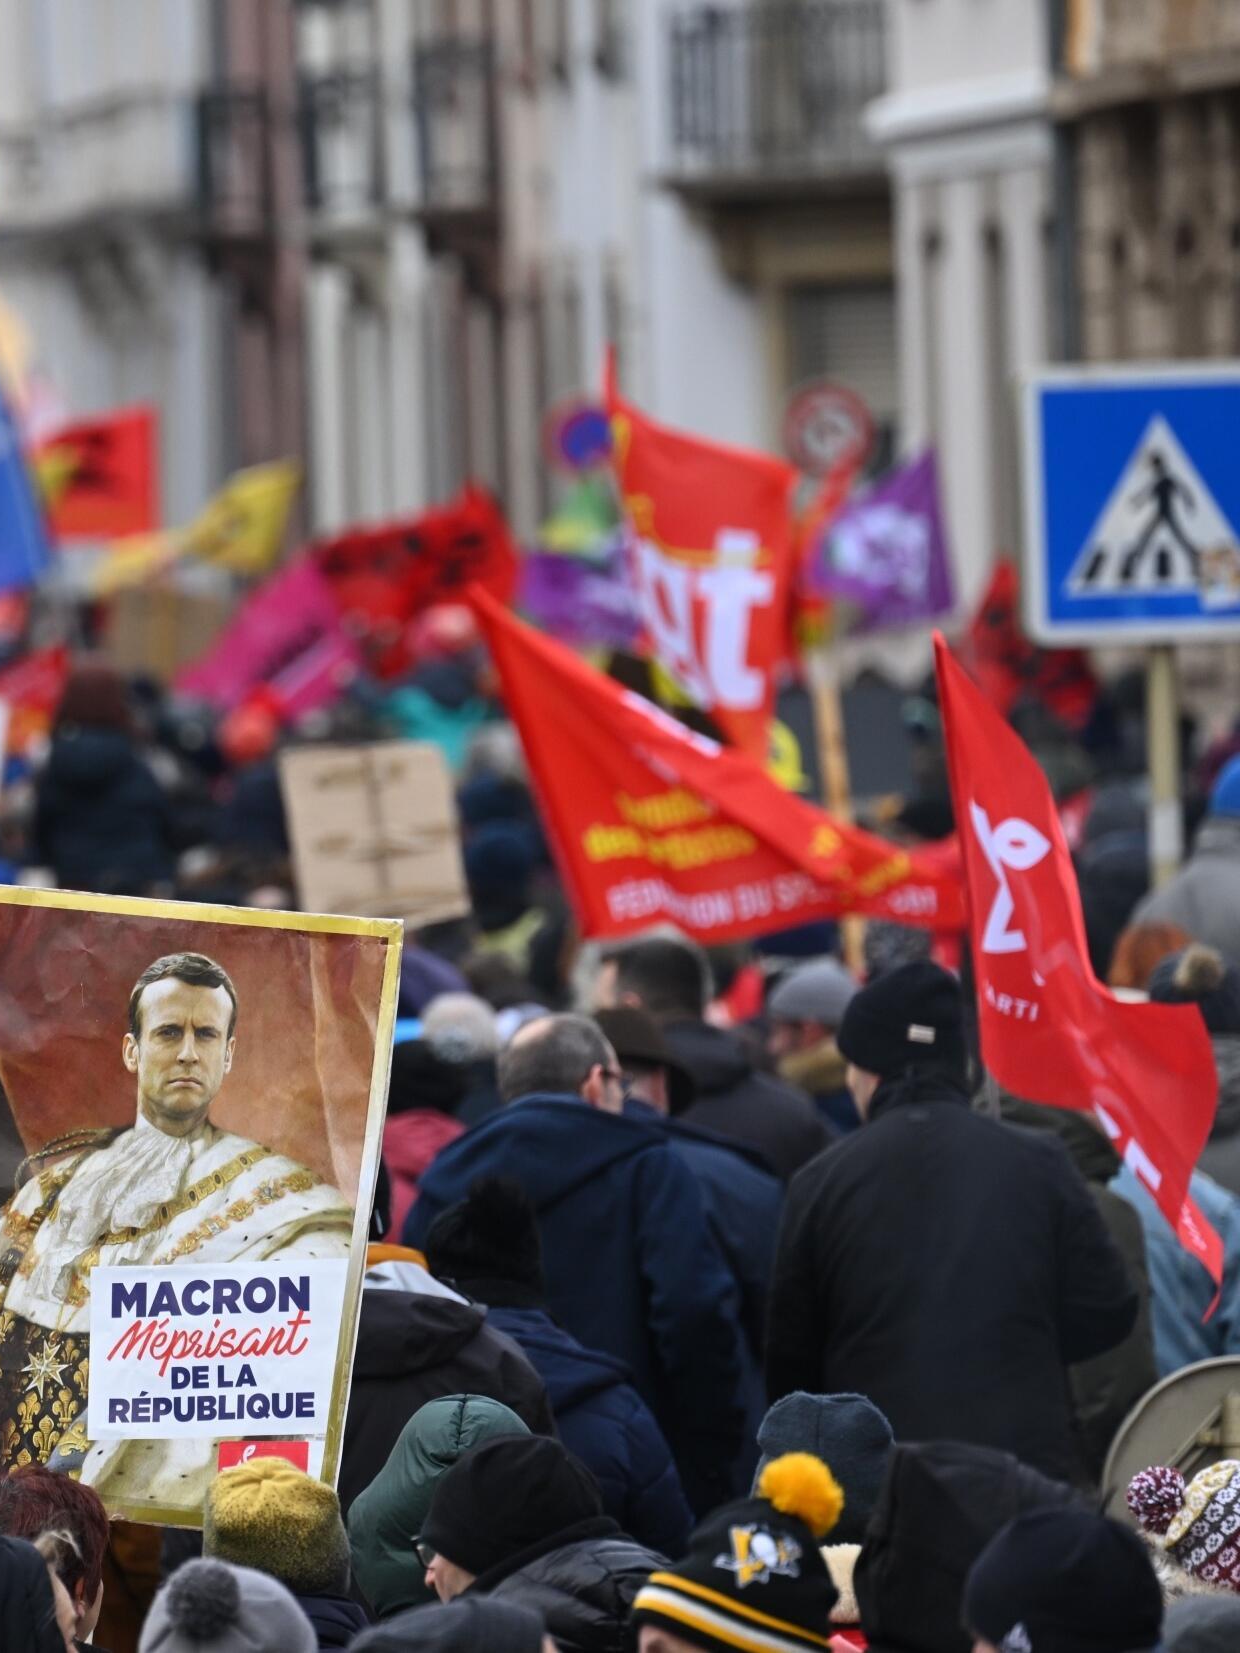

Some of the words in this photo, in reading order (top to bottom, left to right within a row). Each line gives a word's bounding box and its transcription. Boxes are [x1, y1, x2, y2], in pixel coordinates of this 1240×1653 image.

[111, 1276, 310, 1318] MACRON
[107, 1308, 311, 1377] Méprisant
[171, 1365, 210, 1390] DE
[217, 1363, 258, 1389] LA
[108, 1390, 316, 1424] RÉPUBLIQUE
